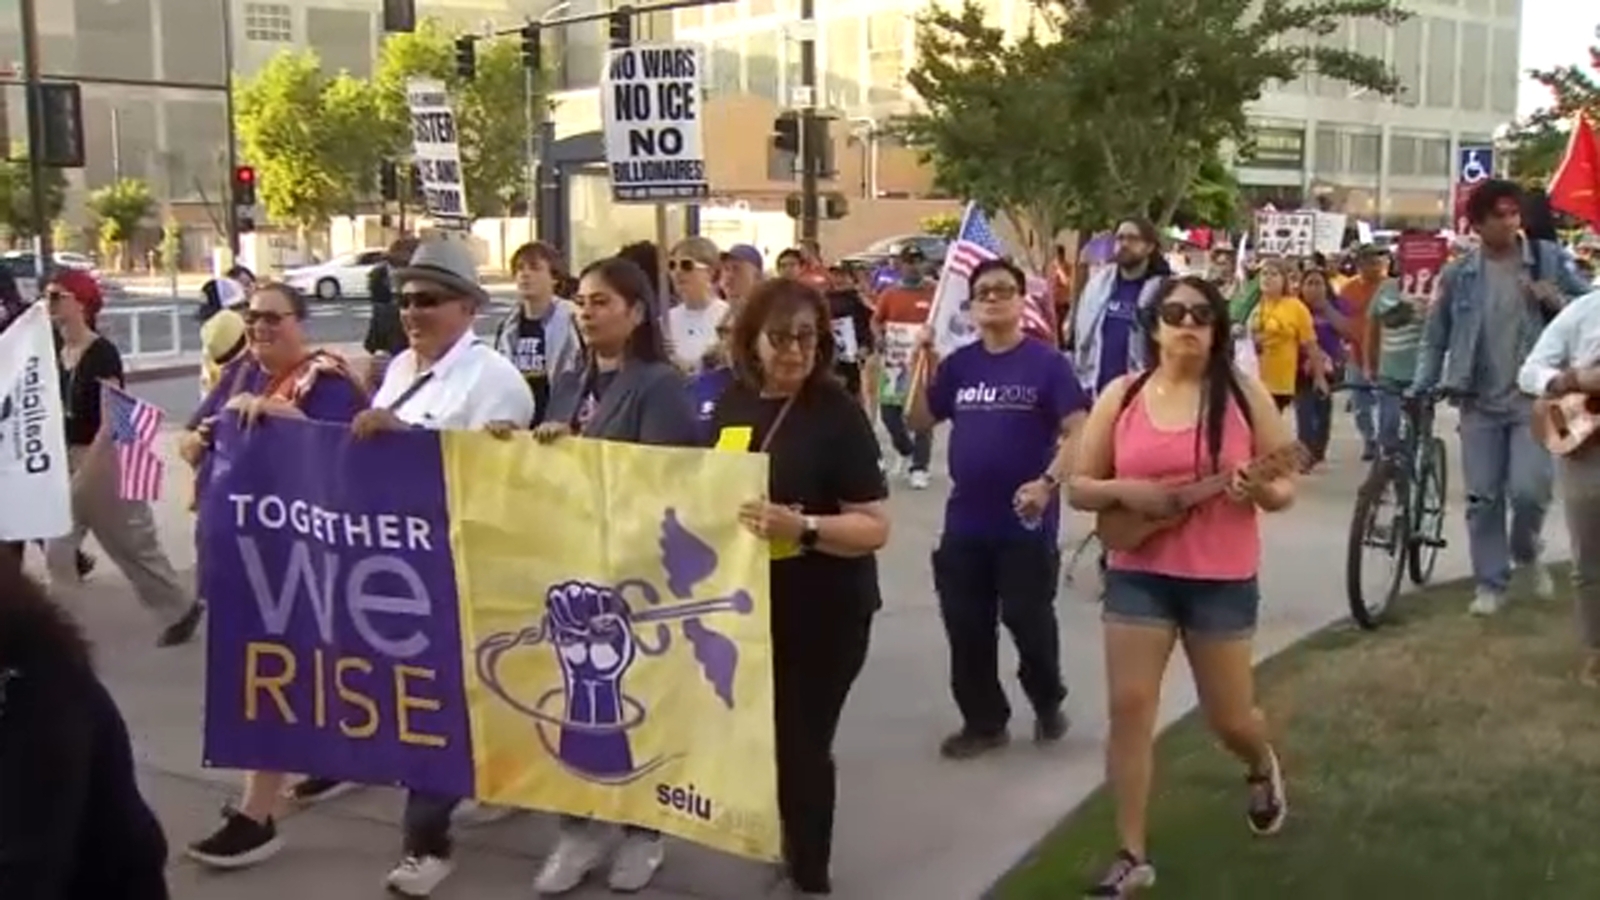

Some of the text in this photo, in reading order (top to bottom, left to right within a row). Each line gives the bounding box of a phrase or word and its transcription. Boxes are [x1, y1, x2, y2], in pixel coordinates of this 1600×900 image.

[610, 49, 695, 80] NO WARS
[615, 82, 695, 121] NO ICE
[629, 127, 683, 156] NO
[612, 160, 706, 182] BILLIONAIRES
[228, 494, 432, 551] TOGETHER
[245, 642, 446, 747] RISE
